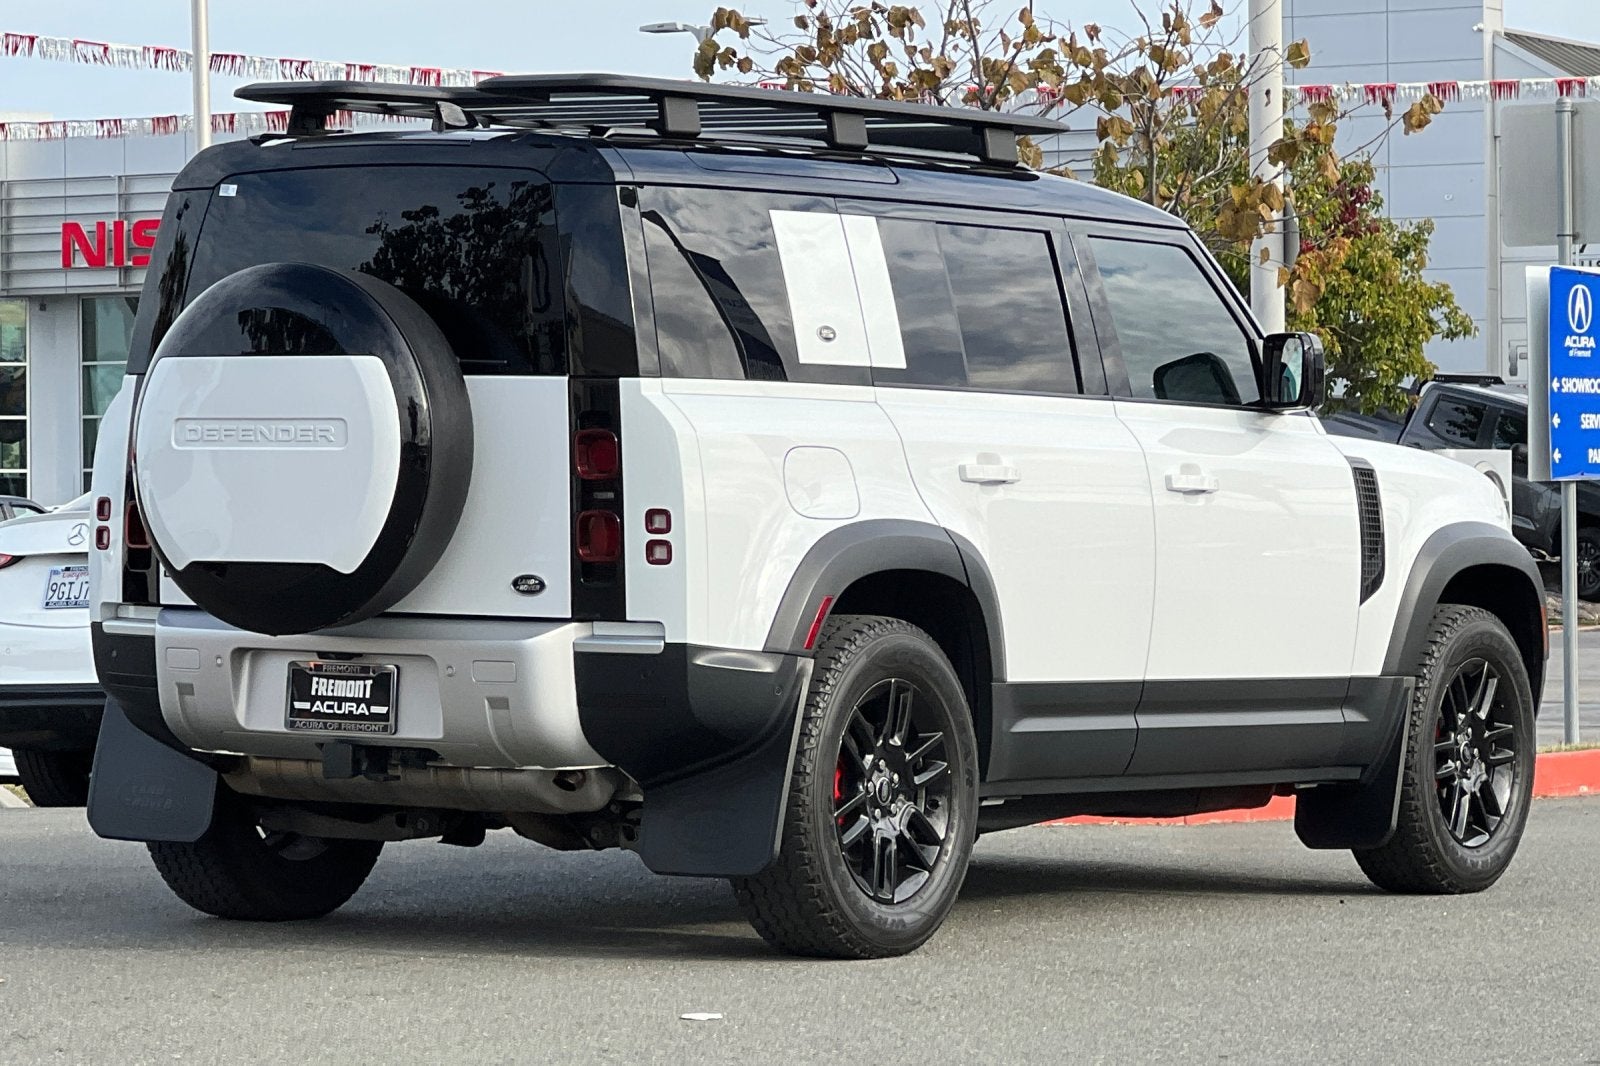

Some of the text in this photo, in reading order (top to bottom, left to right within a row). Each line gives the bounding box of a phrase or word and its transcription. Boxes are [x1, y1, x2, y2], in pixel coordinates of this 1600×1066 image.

[61, 218, 161, 269] NIS
[1564, 335, 1596, 348] ACURA
[185, 424, 335, 443] DEFENDER
[48, 581, 89, 600] 9GIJ7
[322, 665, 361, 673] FREMONT
[311, 677, 373, 698] FREMONT
[311, 701, 369, 716] ACURA
[294, 721, 384, 732] ACURA OF FREMONT
